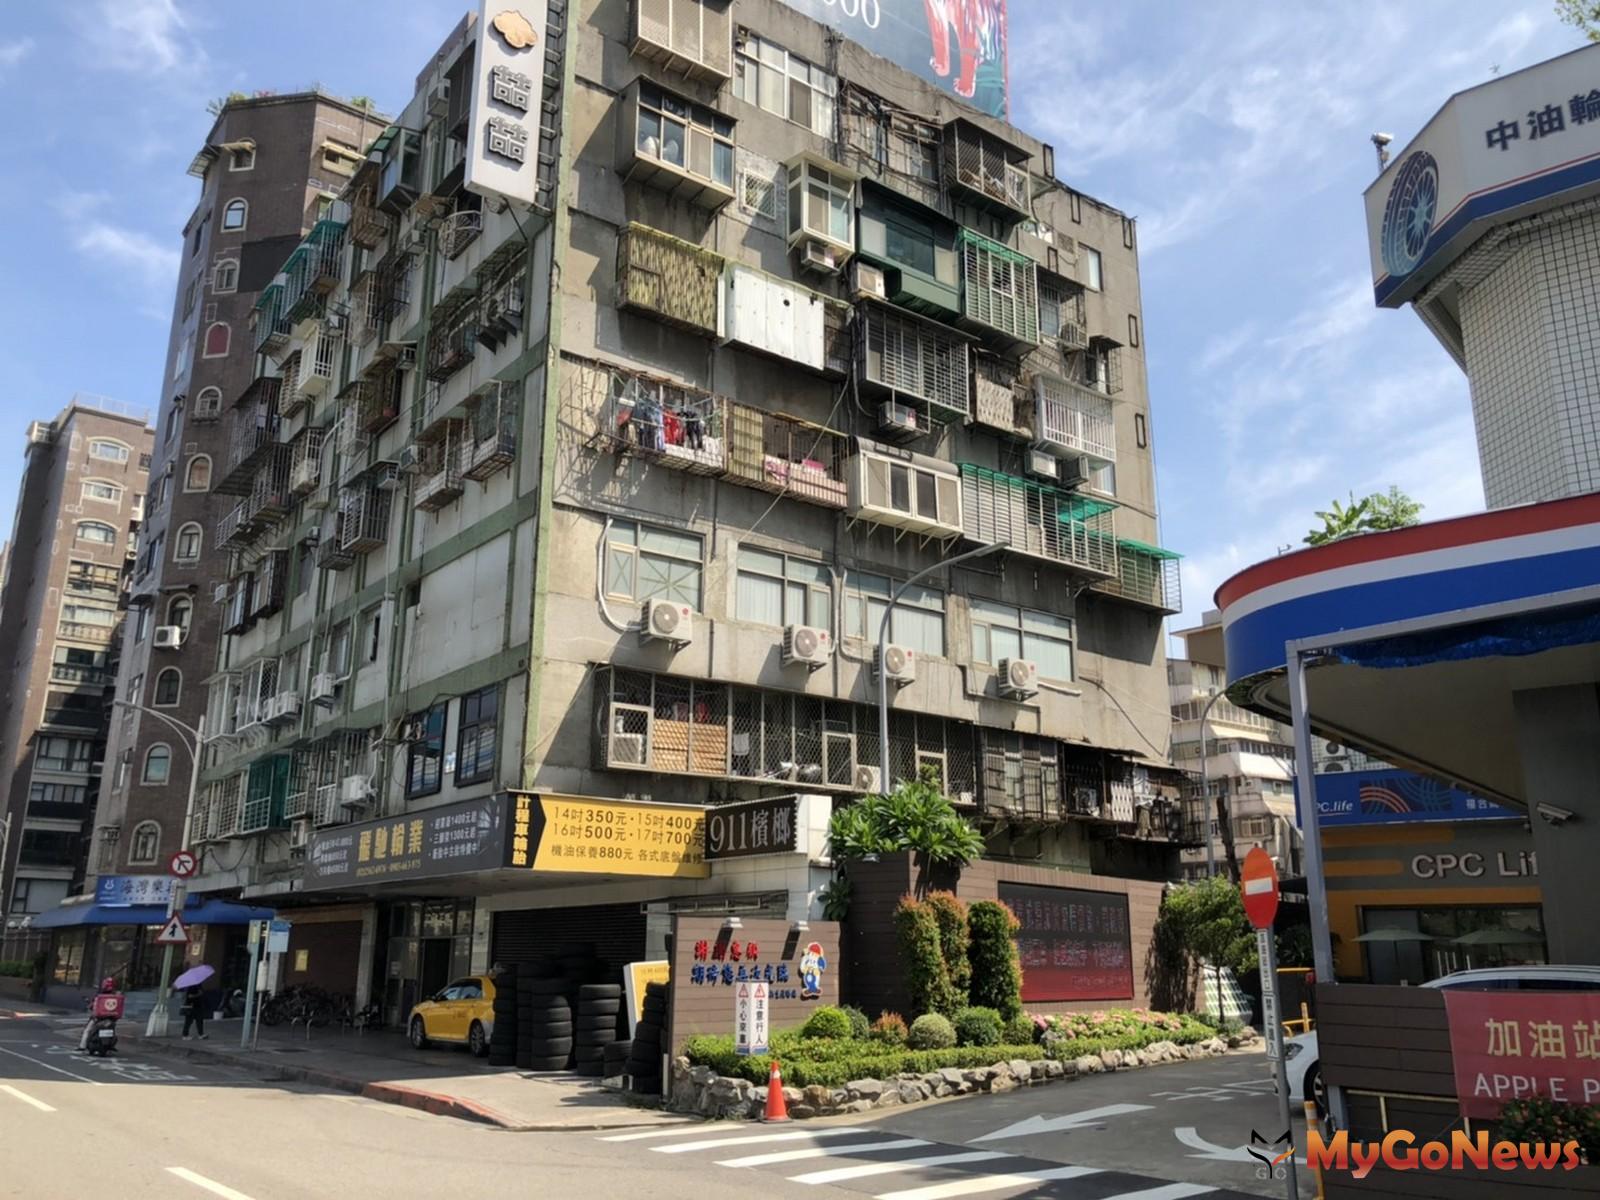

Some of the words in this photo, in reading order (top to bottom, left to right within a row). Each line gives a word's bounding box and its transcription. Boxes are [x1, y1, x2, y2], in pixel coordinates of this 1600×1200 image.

[709, 807, 791, 852] 911檳榔
[551, 844, 634, 861] 機油保養880元
[1411, 852, 1486, 878] CPC
[755, 999, 764, 1045] 注意行人
[1484, 1017, 1600, 1060] 加油站
